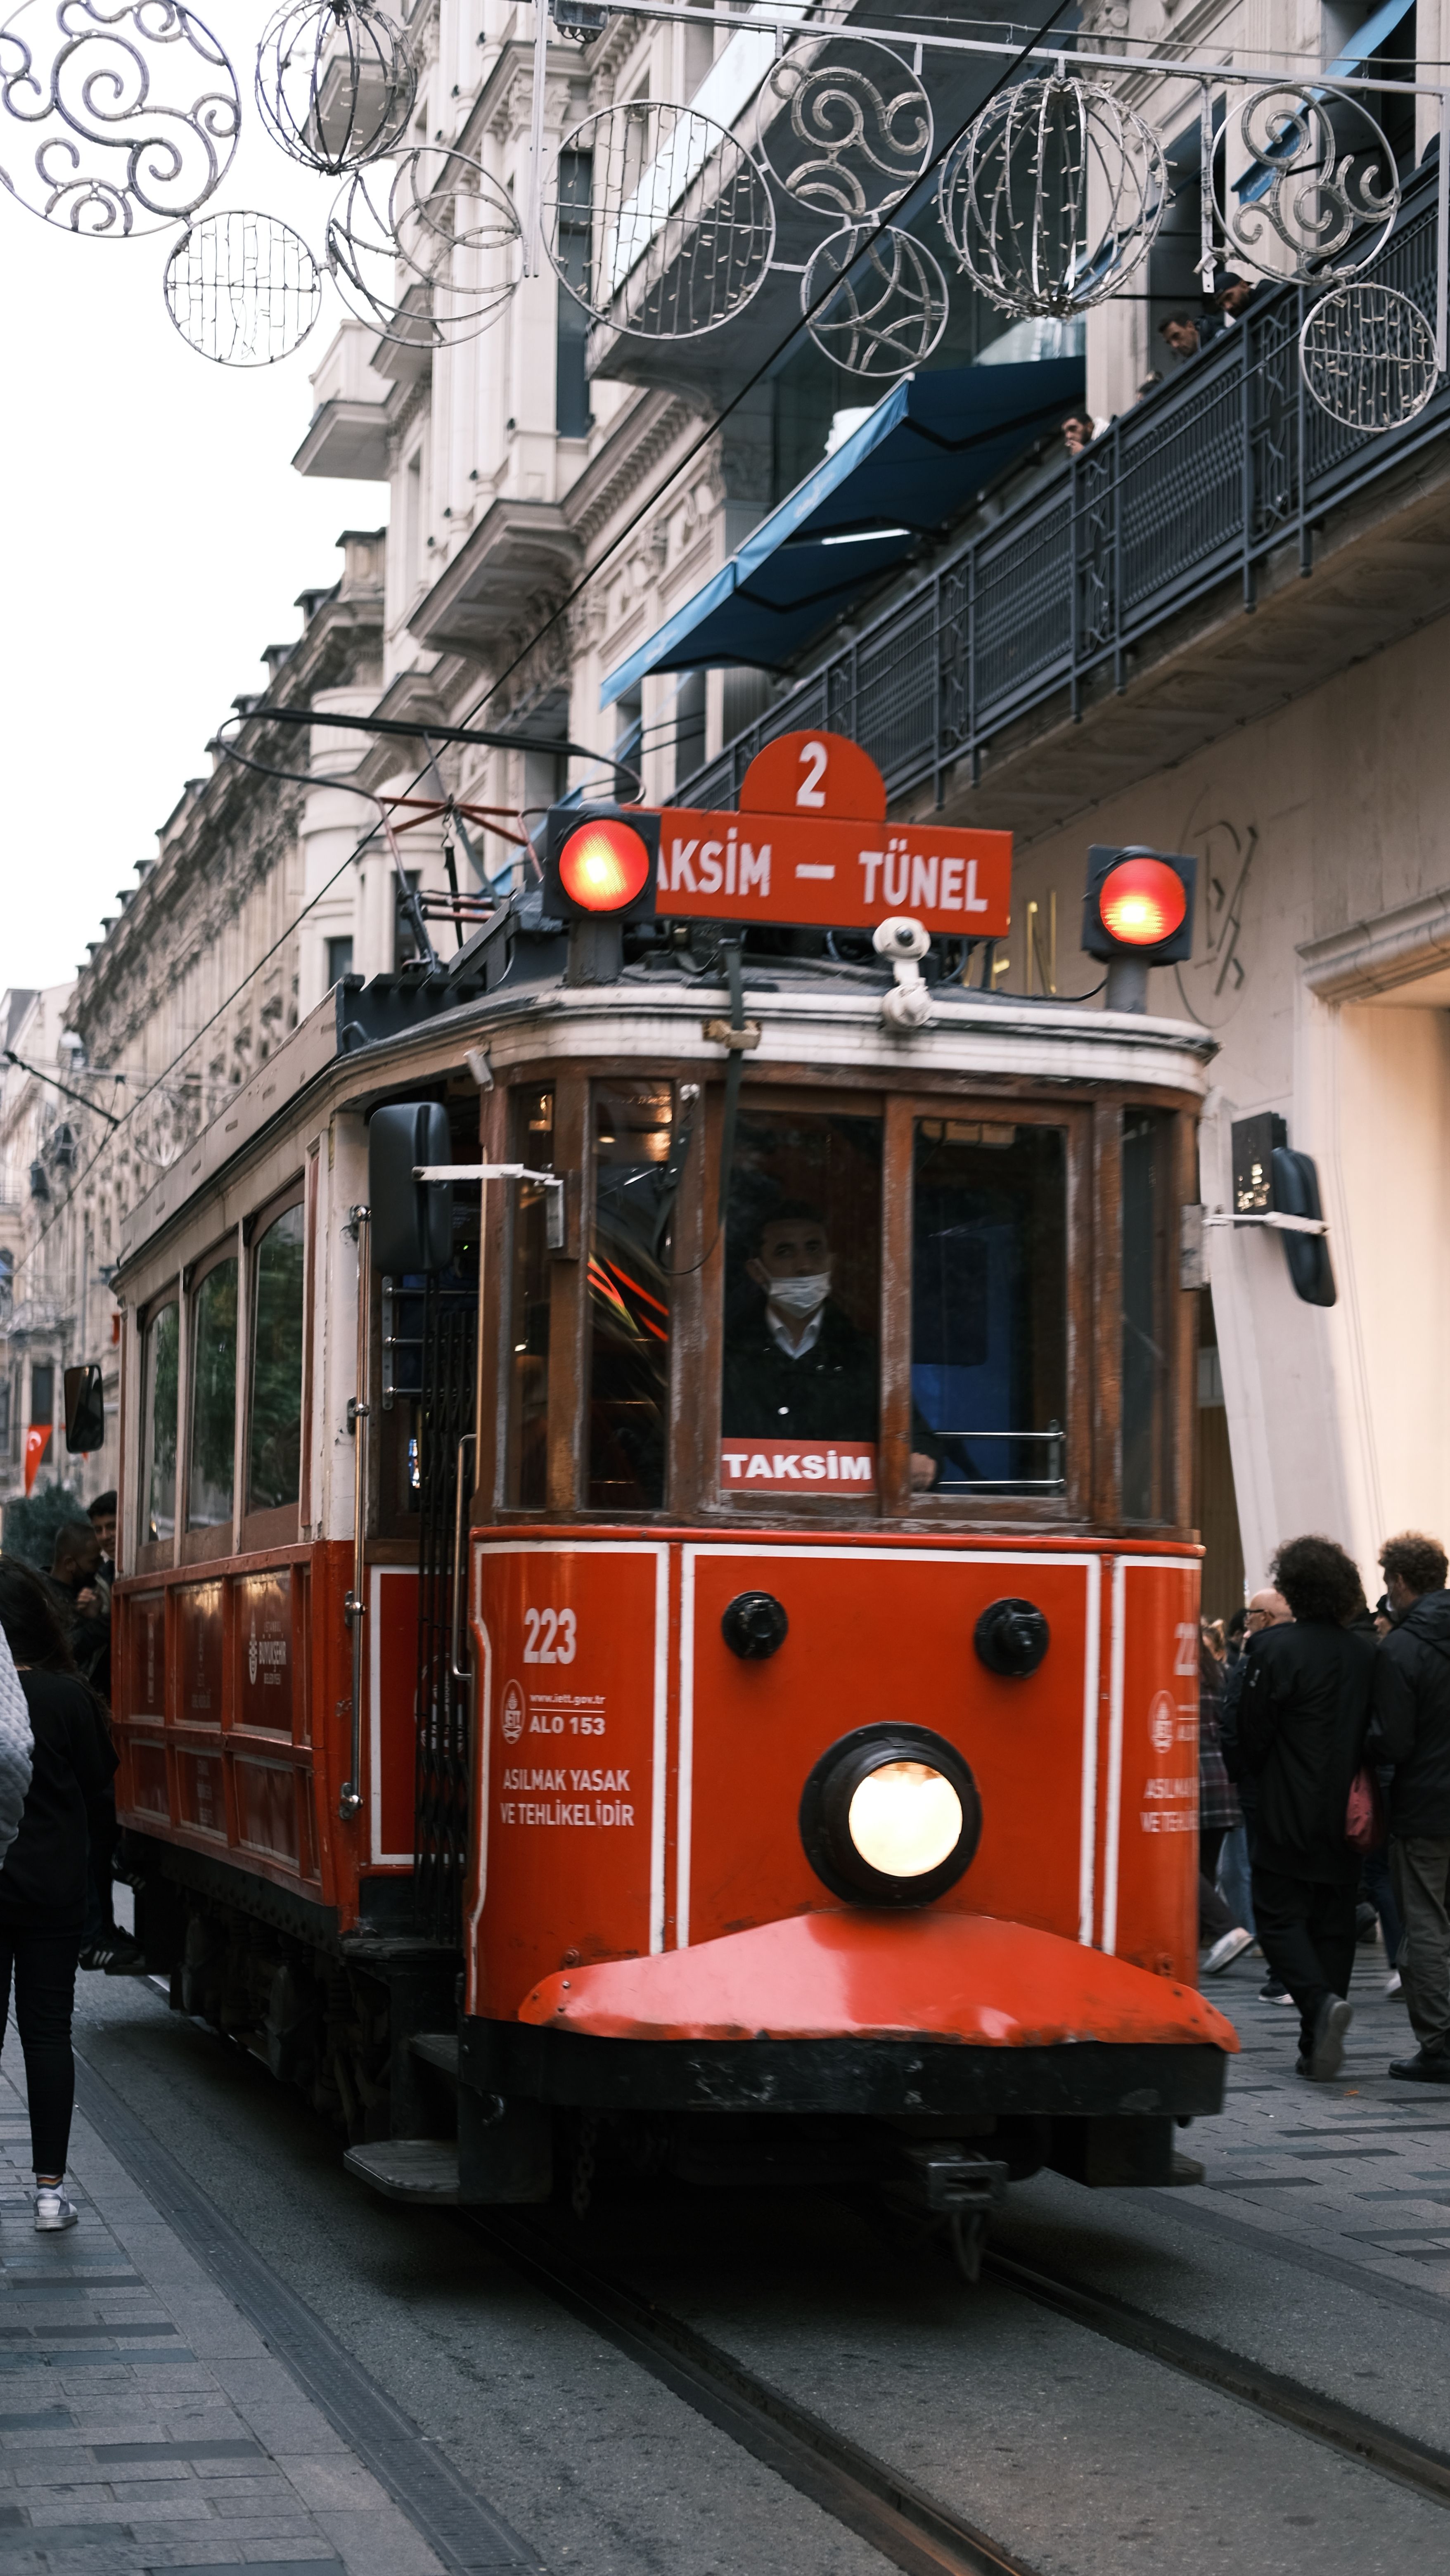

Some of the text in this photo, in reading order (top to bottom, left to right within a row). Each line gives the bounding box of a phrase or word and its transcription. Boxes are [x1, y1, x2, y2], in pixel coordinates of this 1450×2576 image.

[796, 741, 827, 808] 2
[859, 838, 988, 912] TÜNEL
[722, 1450, 872, 1480] TAKSİM
[523, 1608, 576, 1664] 223
[529, 1694, 606, 1705] www.iett.gov.tr
[529, 1716, 606, 1735] ALO 153
[502, 1769, 631, 1791] ASILMAK YASAK
[500, 1799, 635, 1826] VE TEHLİKELİDİR
